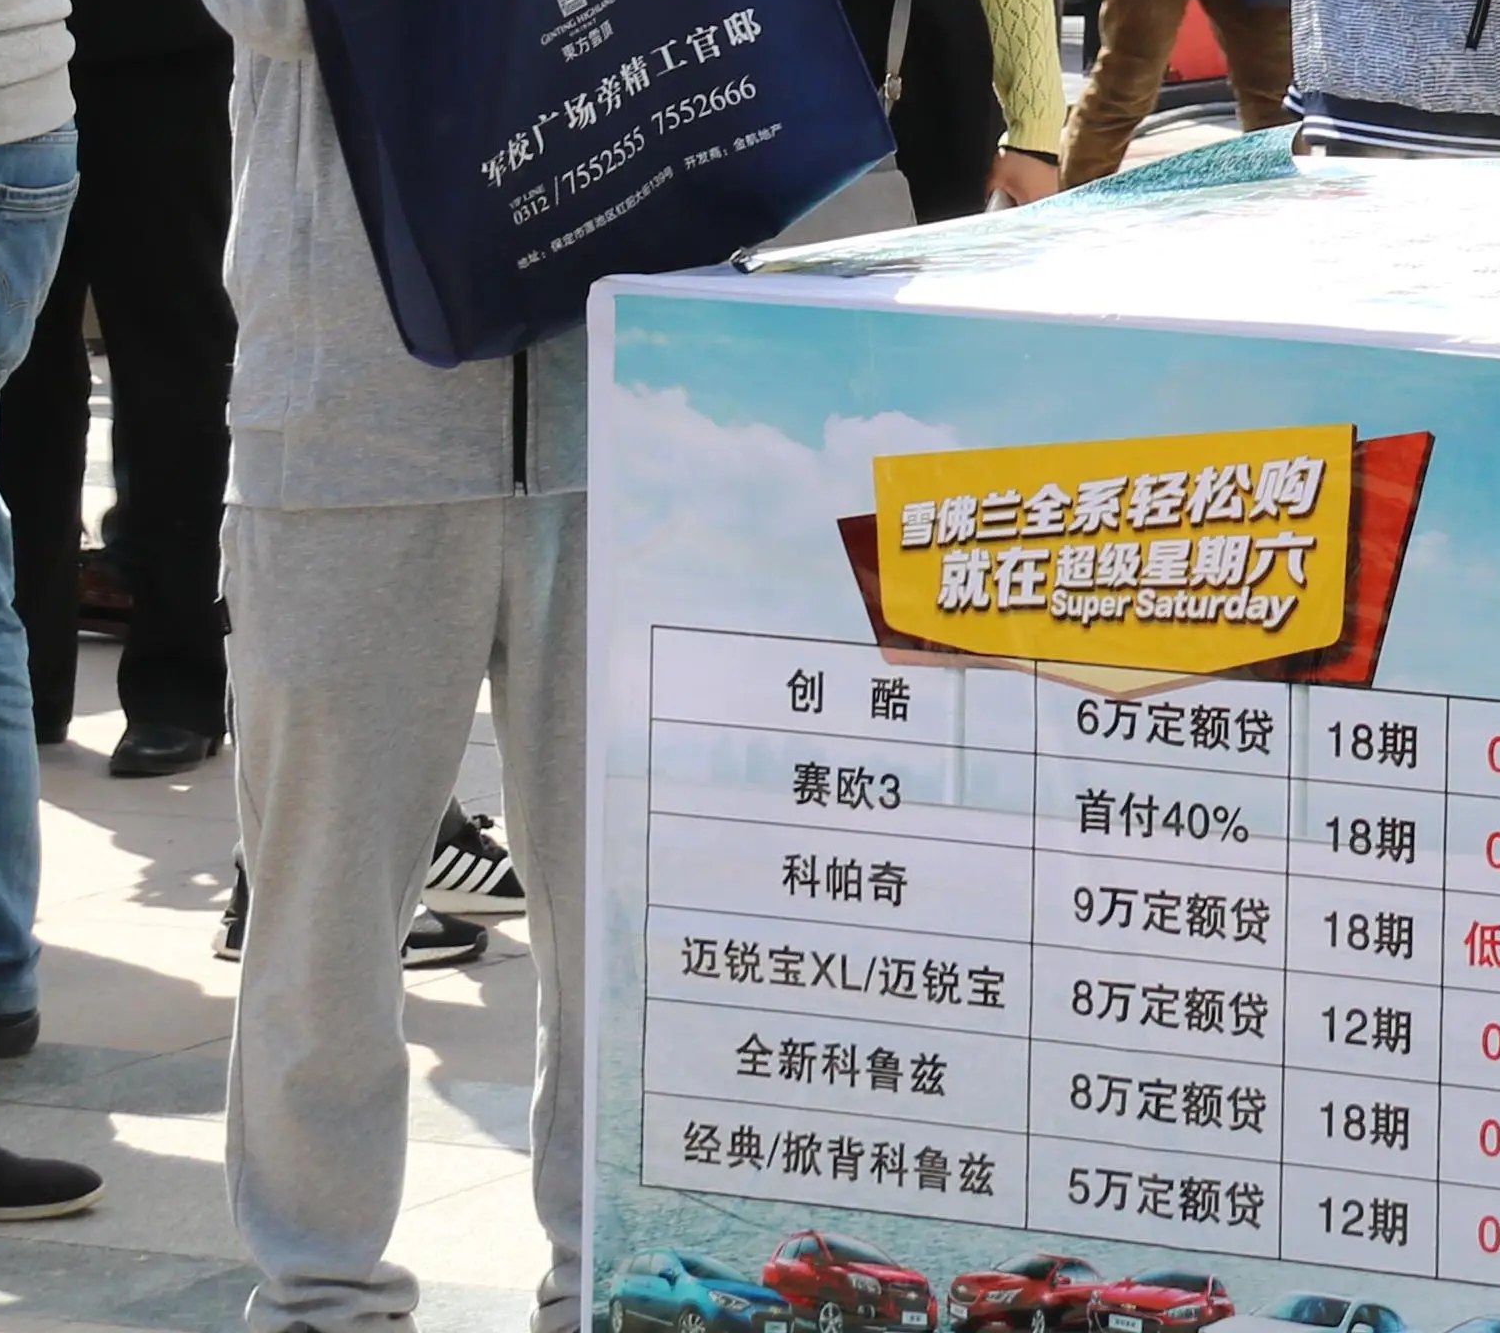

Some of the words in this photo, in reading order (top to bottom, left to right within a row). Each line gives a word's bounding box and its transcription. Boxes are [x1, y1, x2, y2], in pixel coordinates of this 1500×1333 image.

[481, 8, 762, 187] 军校广场旁精工官邸
[513, 196, 550, 225] 0312
[561, 126, 646, 195] 7552555
[651, 75, 757, 135] 7552666
[901, 455, 1326, 550] 雪佛兰全系轻松购
[937, 530, 1315, 612] 就在超级星期六
[1051, 588, 1132, 626] Super
[1136, 585, 1298, 630] Saturday
[1077, 699, 1274, 756] 6万定额贷
[1327, 721, 1419, 770] 18期
[793, 761, 902, 811] 赛欧3
[1075, 788, 1250, 844] 首付40%
[1325, 817, 1417, 865] 18期
[782, 853, 908, 907] 科帕奇
[1074, 886, 1271, 945] 9万定额贷
[1324, 911, 1414, 961] 18期
[681, 936, 1006, 1010] 迈锐宝XL/迈锐宝
[1072, 979, 1269, 1039] 8万定额贷
[1321, 1008, 1413, 1056] 12期
[735, 1032, 948, 1097] 全新科鲁兹
[1070, 1074, 1267, 1134] 8万定额贷
[1320, 1103, 1411, 1151] 18期
[683, 1121, 996, 1197] 经典/掀背科鲁兹
[1068, 1168, 1265, 1230] 5万定额贷
[1318, 1198, 1409, 1247] 12期
